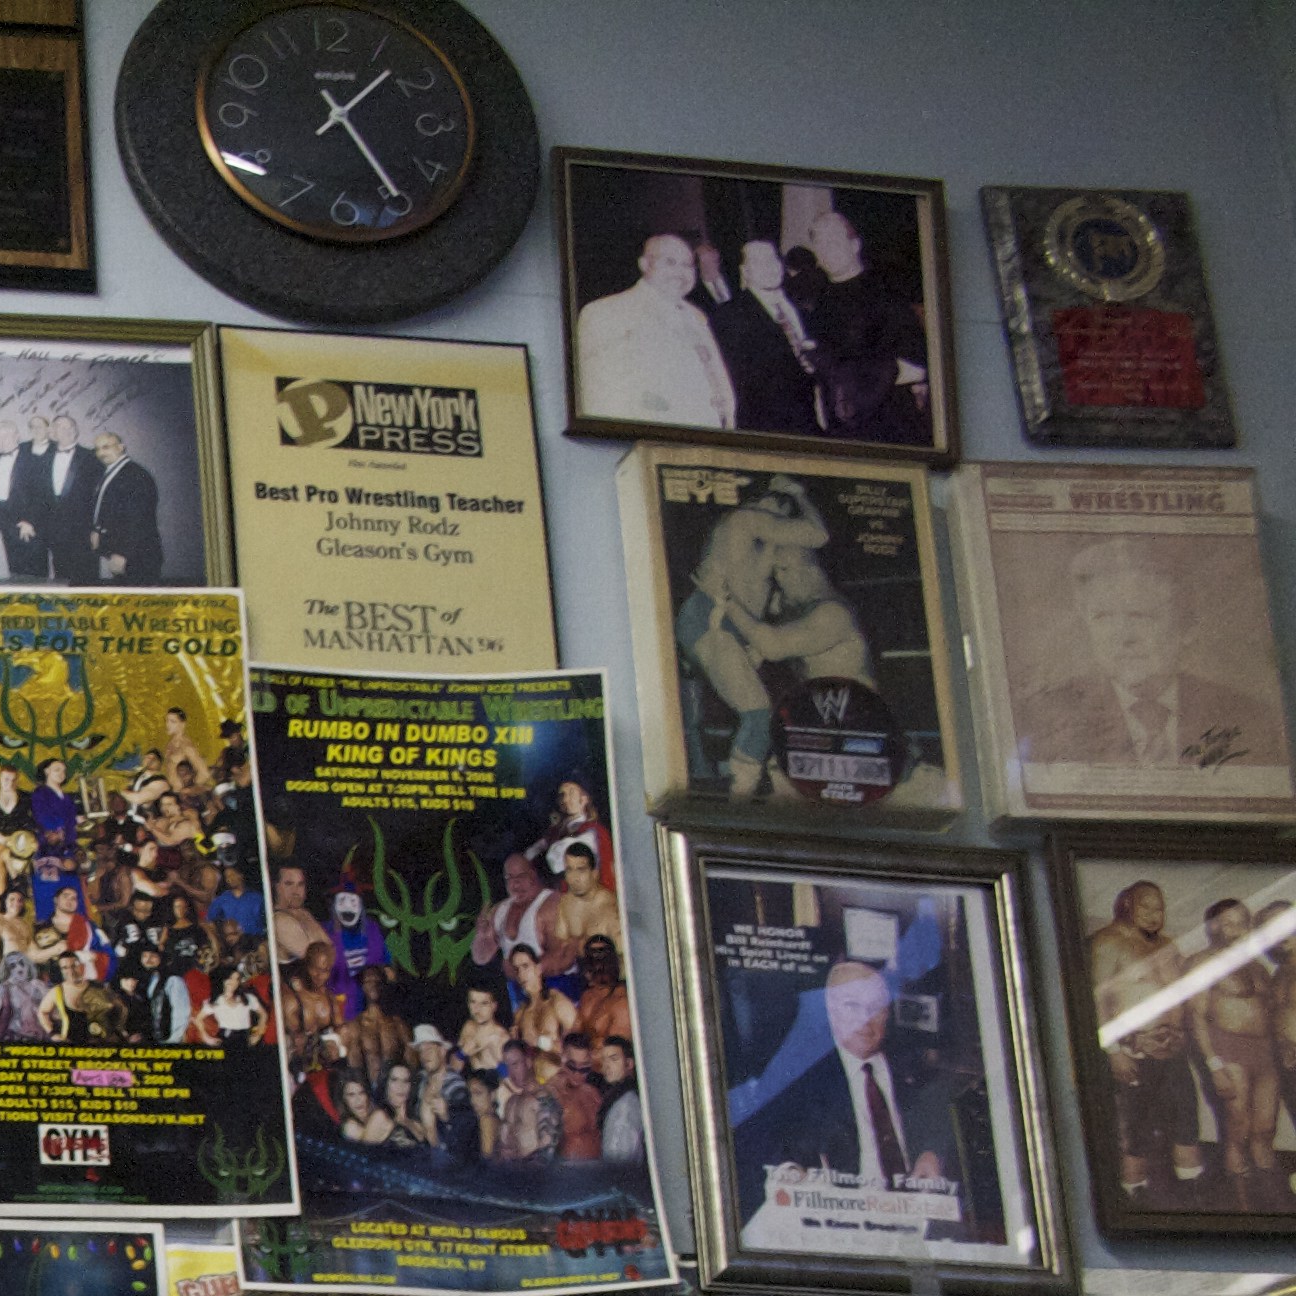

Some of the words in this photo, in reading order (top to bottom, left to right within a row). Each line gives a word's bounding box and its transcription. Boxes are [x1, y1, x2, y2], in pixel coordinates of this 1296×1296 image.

[314, 18, 350, 53] 12
[358, 428, 482, 455] PRESS
[255, 482, 299, 502] Best
[304, 485, 338, 504] Pro
[344, 486, 441, 514] Wrestling
[447, 491, 525, 514] Teacher
[324, 511, 401, 537] Johnny
[408, 514, 461, 537] Rodz
[316, 537, 418, 561] Gleason's
[424, 544, 474, 567] Gym
[304, 598, 340, 617] The
[344, 599, 437, 634] BEST
[440, 607, 464, 625] of
[33, 633, 88, 654] FOR
[99, 635, 155, 655] THE
[162, 637, 239, 658] GOLD
[303, 628, 474, 656] MANHATTAN
[287, 718, 370, 741] RUMBO
[376, 721, 401, 742] IN
[404, 722, 489, 745] DUMBO
[493, 724, 534, 746] XIII
[326, 743, 384, 765] KING
[390, 746, 420, 765] OF
[425, 747, 498, 768] KINGS
